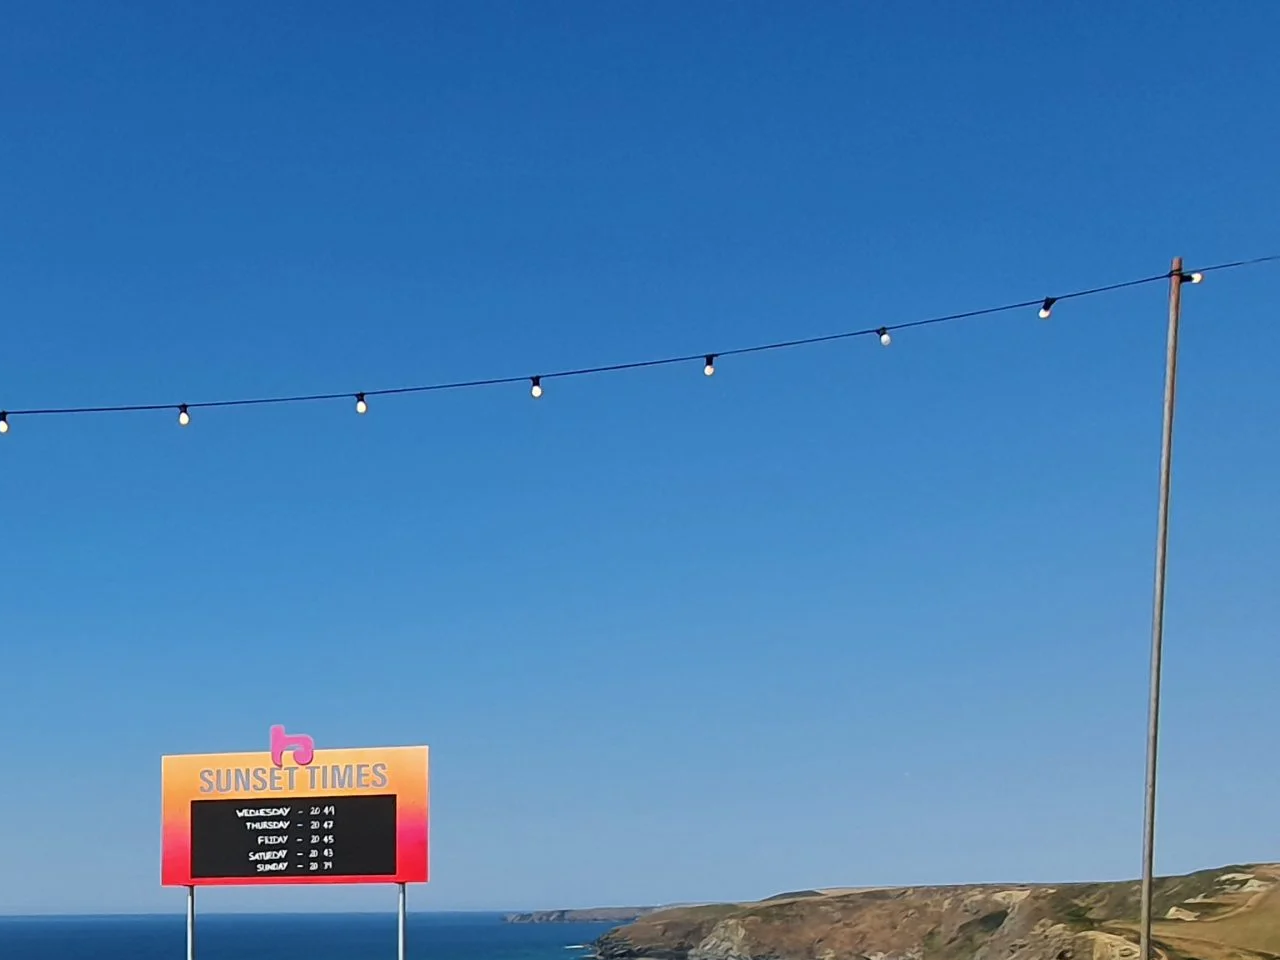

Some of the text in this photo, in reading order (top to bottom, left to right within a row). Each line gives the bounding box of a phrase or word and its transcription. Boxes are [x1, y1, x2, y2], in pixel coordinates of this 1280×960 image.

[199, 763, 388, 793] SUNSET TIMES
[245, 820, 291, 830] THURSDAY
[257, 834, 288, 845] FRIDAY
[248, 849, 288, 861] SATURDAY
[256, 861, 288, 872] SUNDAY
